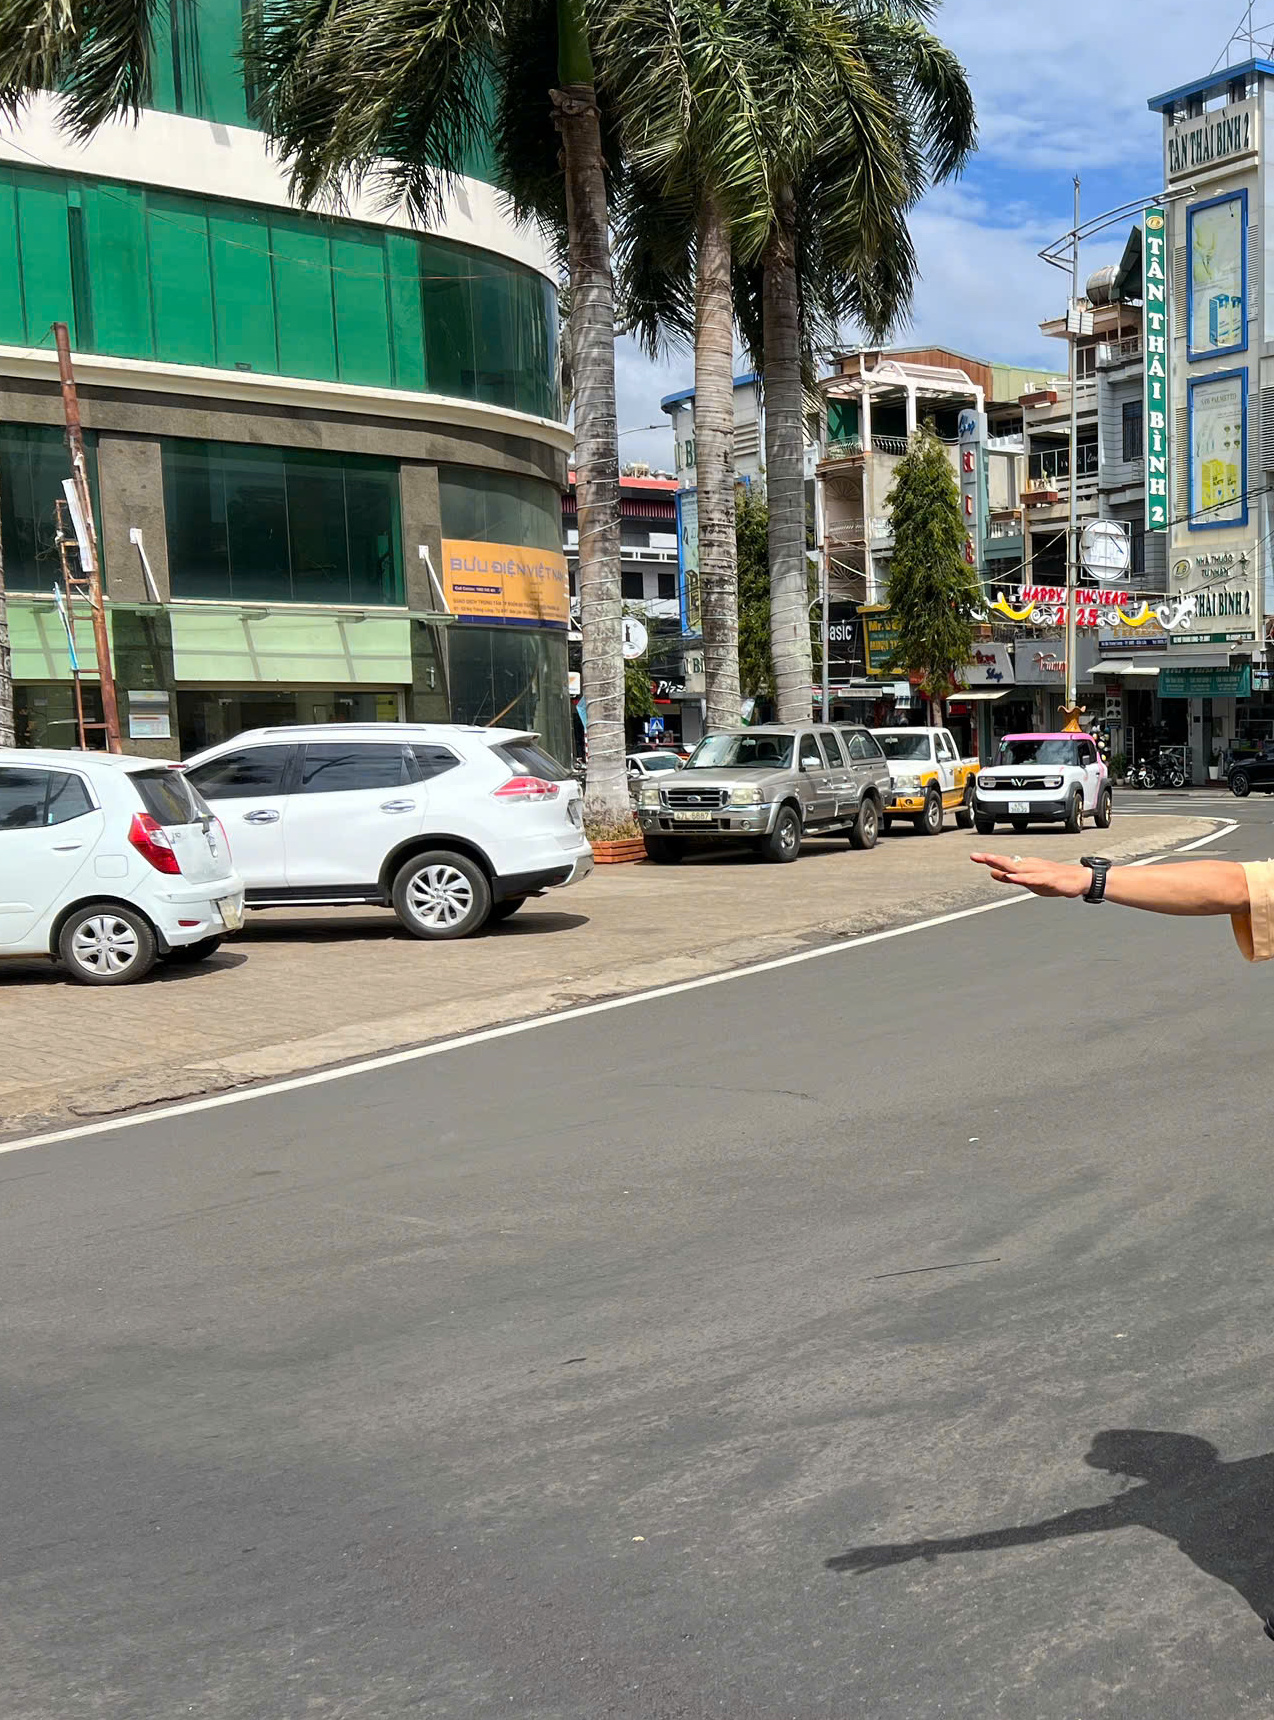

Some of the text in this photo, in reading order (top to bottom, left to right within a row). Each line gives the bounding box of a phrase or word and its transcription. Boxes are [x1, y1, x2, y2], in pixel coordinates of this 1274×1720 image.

[1168, 109, 1250, 173] TÂN THÁI BÌNH 2
[1147, 237, 1166, 522] TÂN THÁI BÌNH 2
[449, 556, 488, 573] BƯU
[491, 559, 527, 577] ĐIỆN
[1021, 585, 1129, 606] HAPPY EW YEAR
[1218, 582, 1242, 617] BÌNH
[1245, 590, 1251, 615] 2
[1056, 606, 1099, 627] 225
